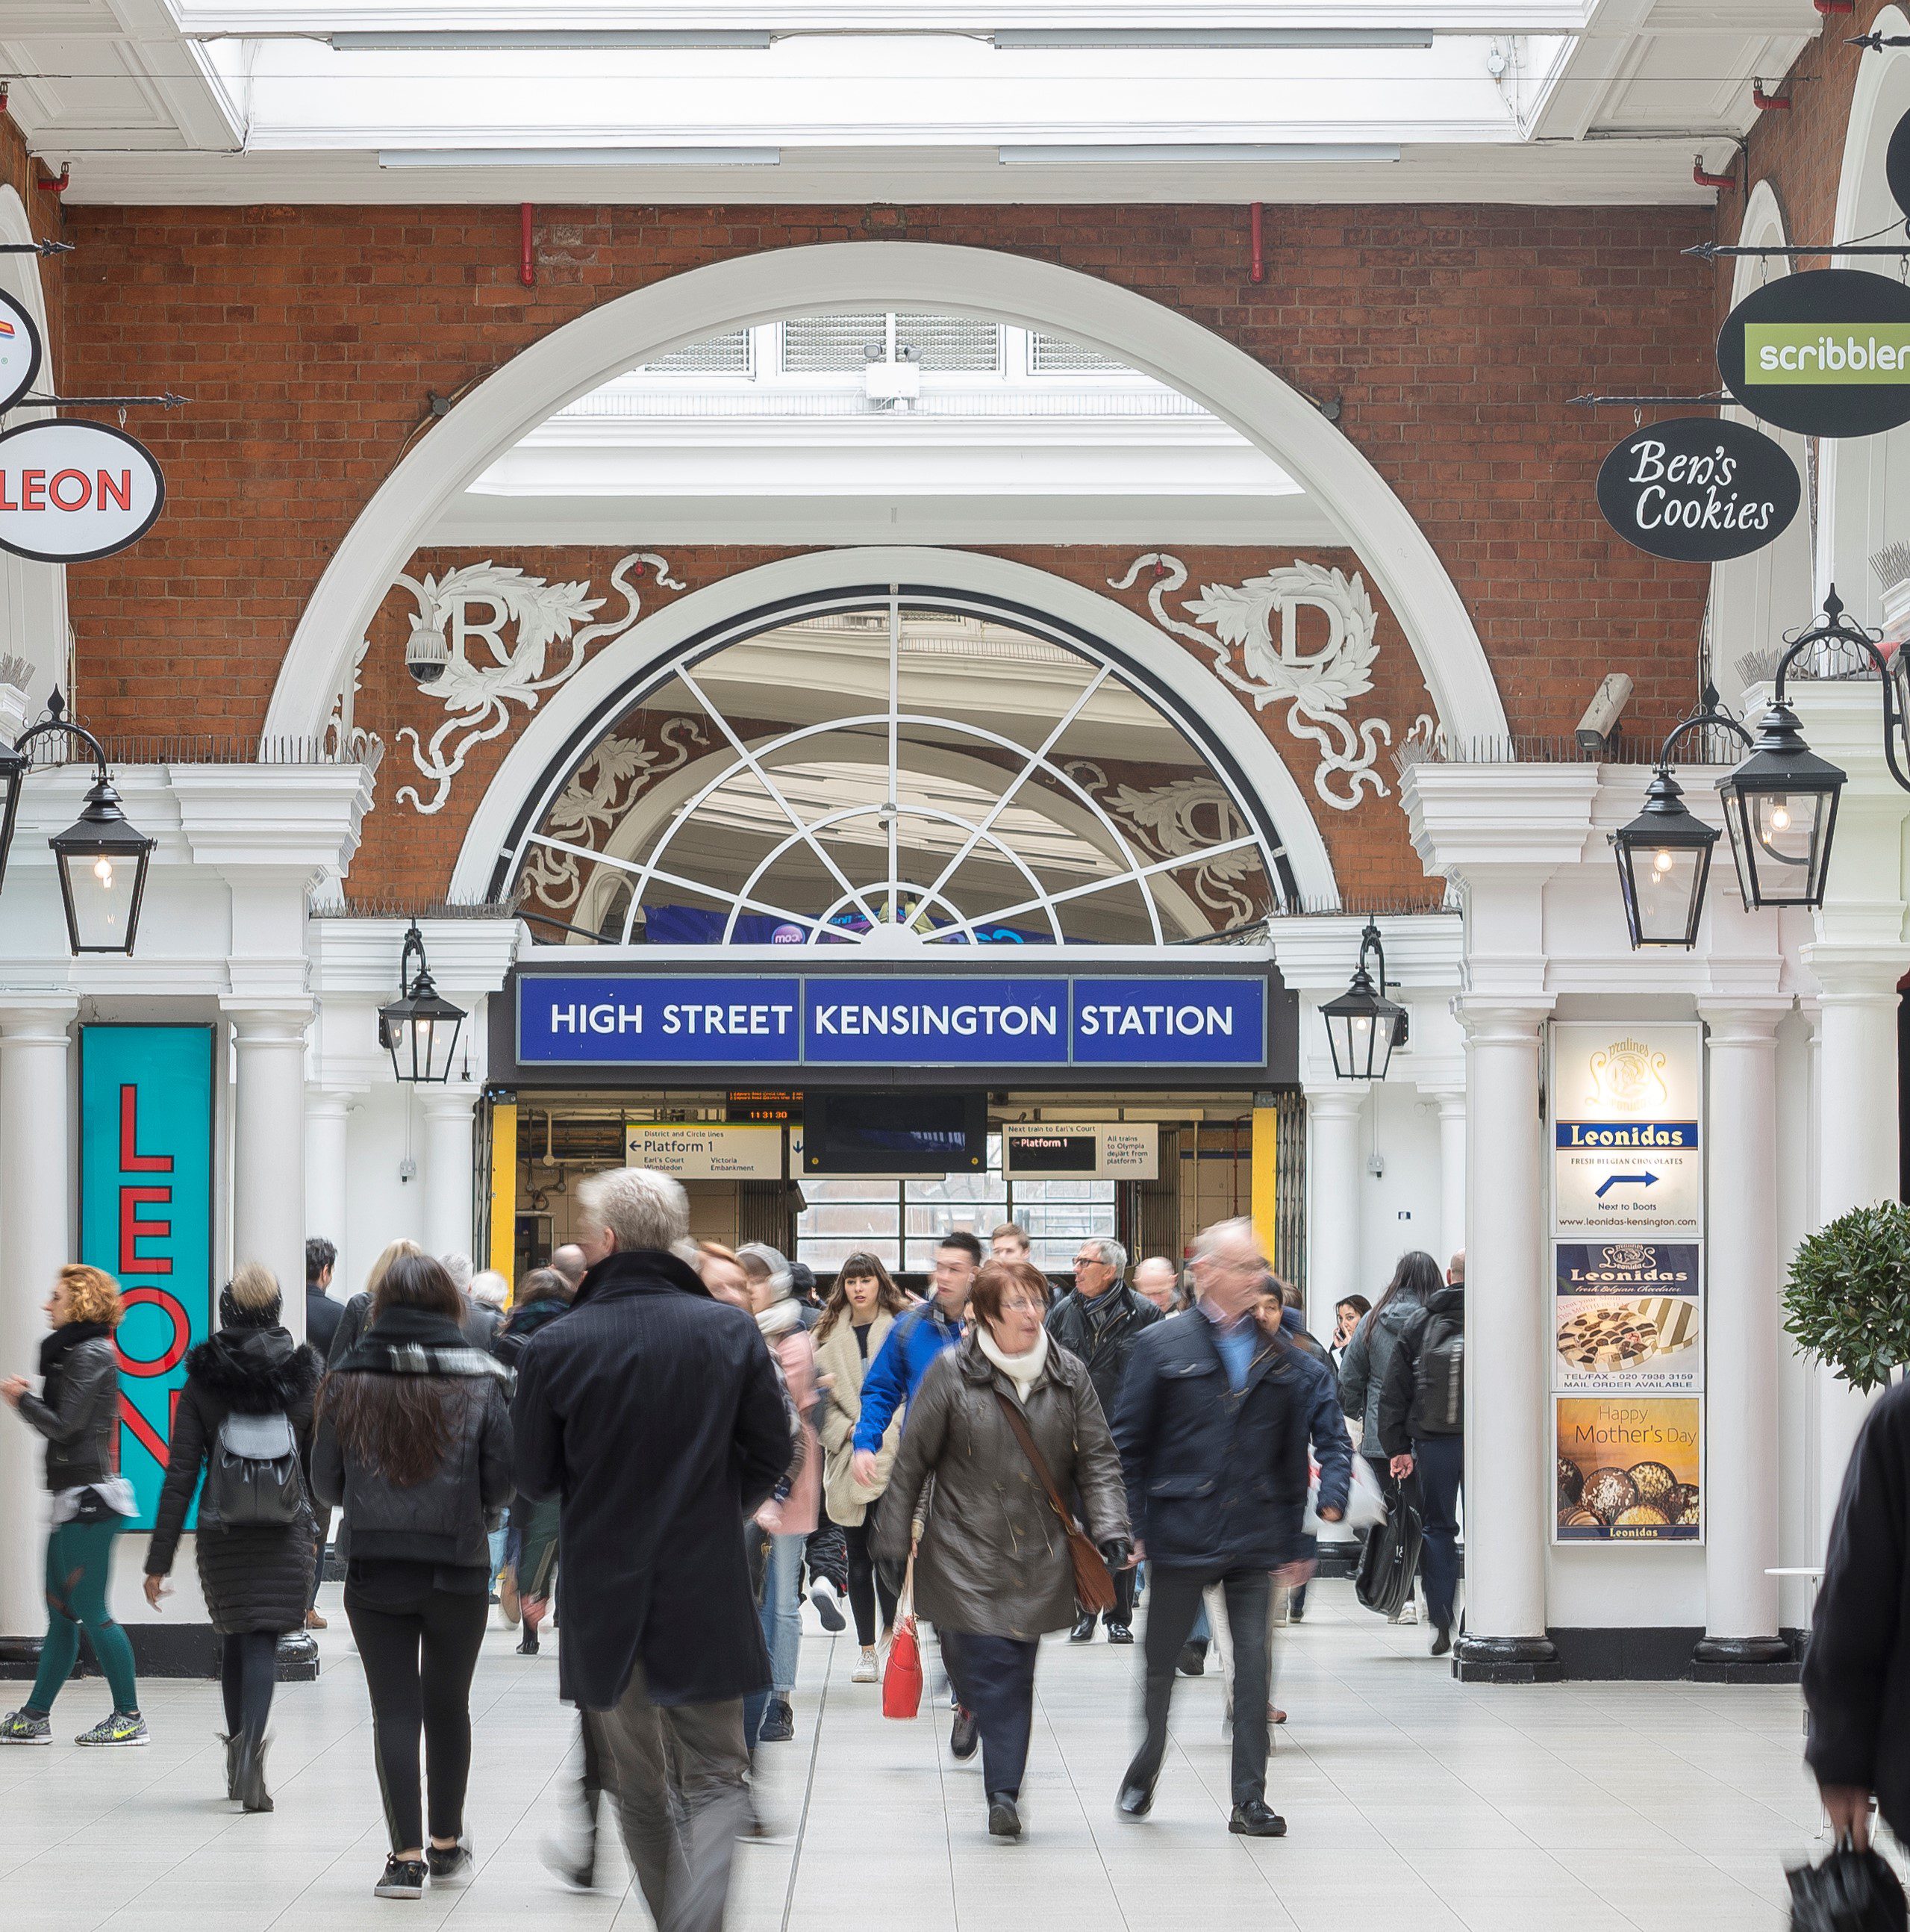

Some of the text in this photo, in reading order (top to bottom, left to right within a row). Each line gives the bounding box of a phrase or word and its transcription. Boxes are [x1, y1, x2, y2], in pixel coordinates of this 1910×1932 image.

[1759, 336, 1910, 371] scribbler
[1629, 440, 1737, 485] Ben's
[0, 468, 131, 511] LEON
[1635, 484, 1775, 530] Cookies
[449, 594, 515, 667] R
[1280, 595, 1345, 667] D
[551, 1004, 1233, 1035] HIGH STREET KENSINGTON STATION
[1608, 1037, 1649, 1058] pralines
[1021, 1138, 1067, 1147] Platform 1
[1570, 1124, 1683, 1146] Leonidas
[644, 1141, 714, 1152] Platform 1
[1117, 1143, 1145, 1151] Olympia
[1559, 1218, 1697, 1227] www.leonidas-kensington.com
[112, 1083, 192, 1473] LEON
[1570, 1269, 1688, 1281] Leonidas
[1600, 1285, 1635, 1294] Belgian
[1600, 1406, 1648, 1424] Happy
[1576, 1425, 1697, 1446] Mother's Day
[1610, 1527, 1658, 1537] Leonidas
